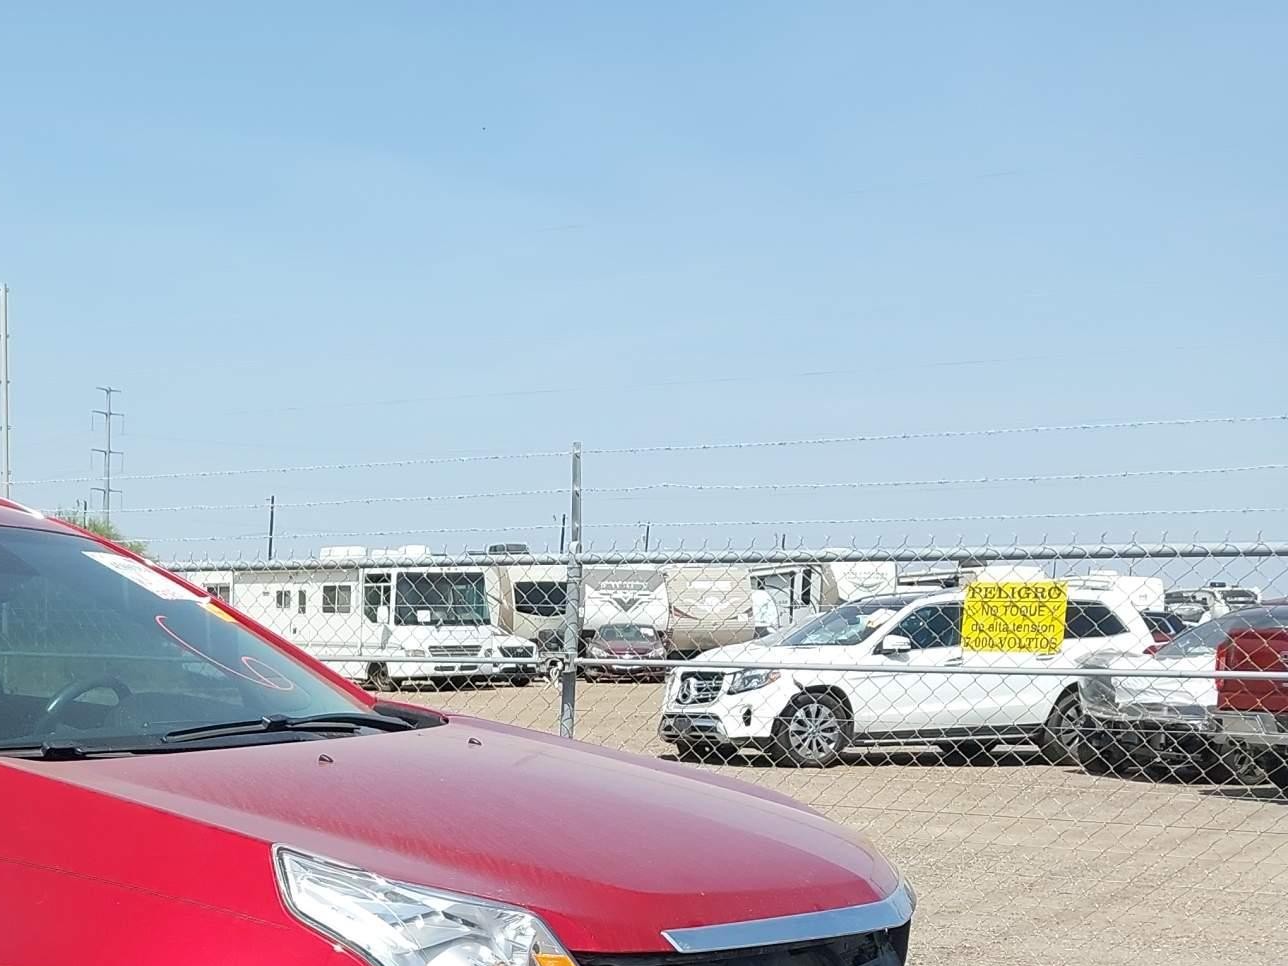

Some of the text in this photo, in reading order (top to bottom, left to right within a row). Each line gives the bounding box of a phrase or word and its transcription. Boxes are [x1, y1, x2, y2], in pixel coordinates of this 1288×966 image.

[970, 586, 1062, 599] PELIGRO
[981, 605, 1045, 617] NO TOQUE
[971, 622, 1055, 633] de alta tension
[999, 637, 1057, 650] VOLTIOS
